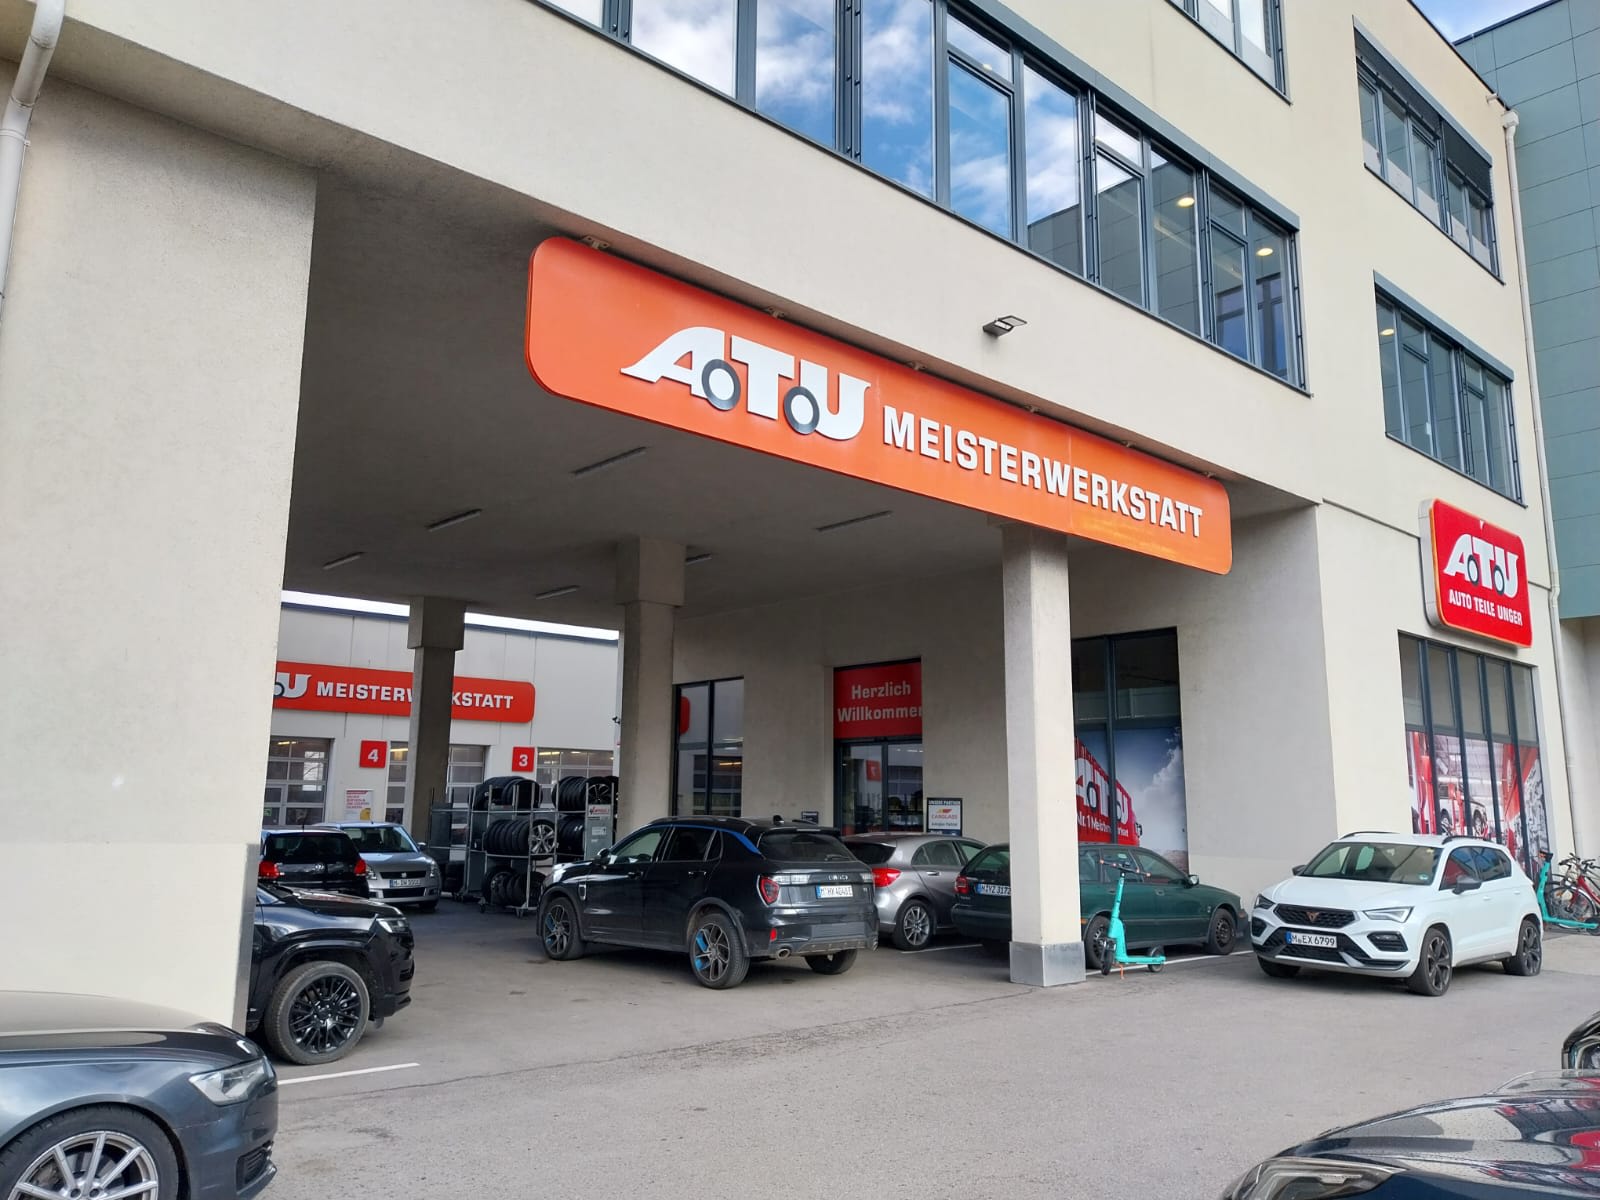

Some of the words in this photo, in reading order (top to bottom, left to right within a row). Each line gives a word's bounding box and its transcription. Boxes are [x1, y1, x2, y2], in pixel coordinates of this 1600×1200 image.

[884, 405, 1203, 537] MEISTERWERKSTATT
[1449, 589, 1472, 610] AUTO
[1474, 597, 1496, 617] TEILE
[1497, 605, 1523, 626] UNGER
[851, 681, 911, 699] Herzlich
[367, 748, 378, 762] 4
[518, 754, 528, 767] 3
[1302, 935, 1313, 945] EX
[1314, 936, 1335, 946] 6799
